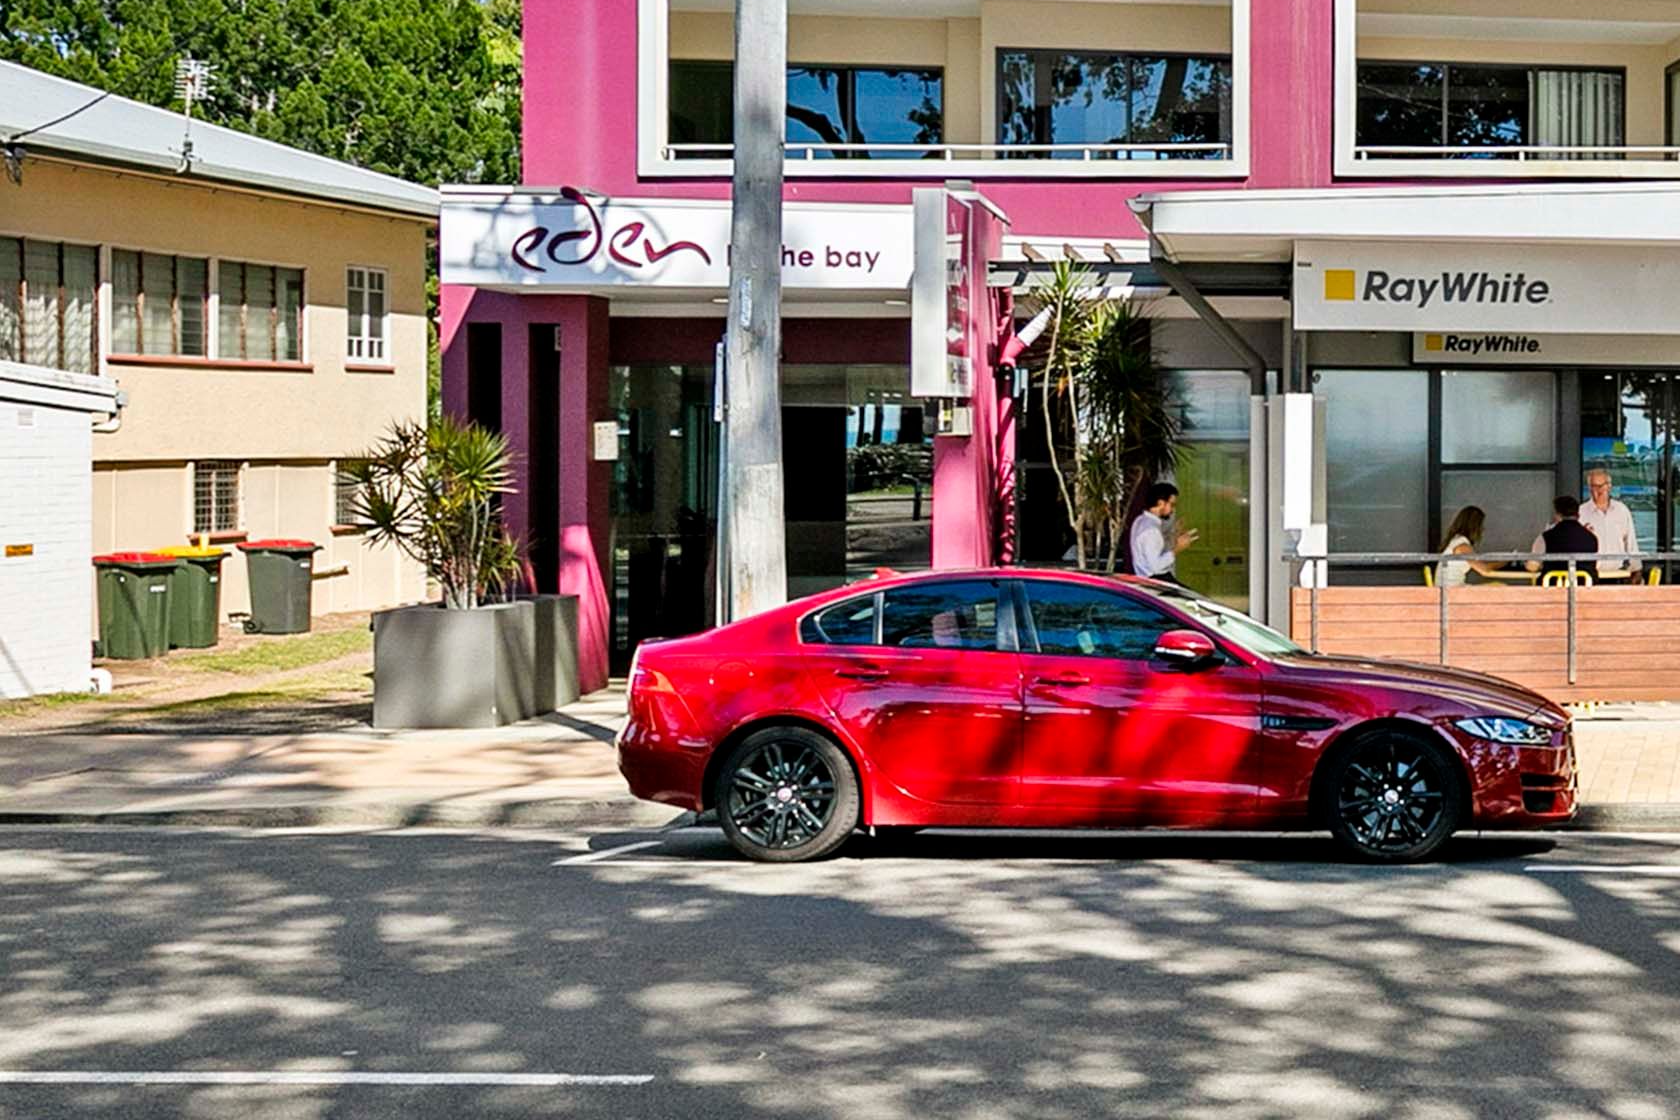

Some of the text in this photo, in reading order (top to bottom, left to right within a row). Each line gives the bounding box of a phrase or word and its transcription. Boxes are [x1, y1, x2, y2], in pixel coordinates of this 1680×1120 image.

[511, 186, 711, 273] eden
[781, 244, 815, 268] he
[825, 245, 880, 273] bay
